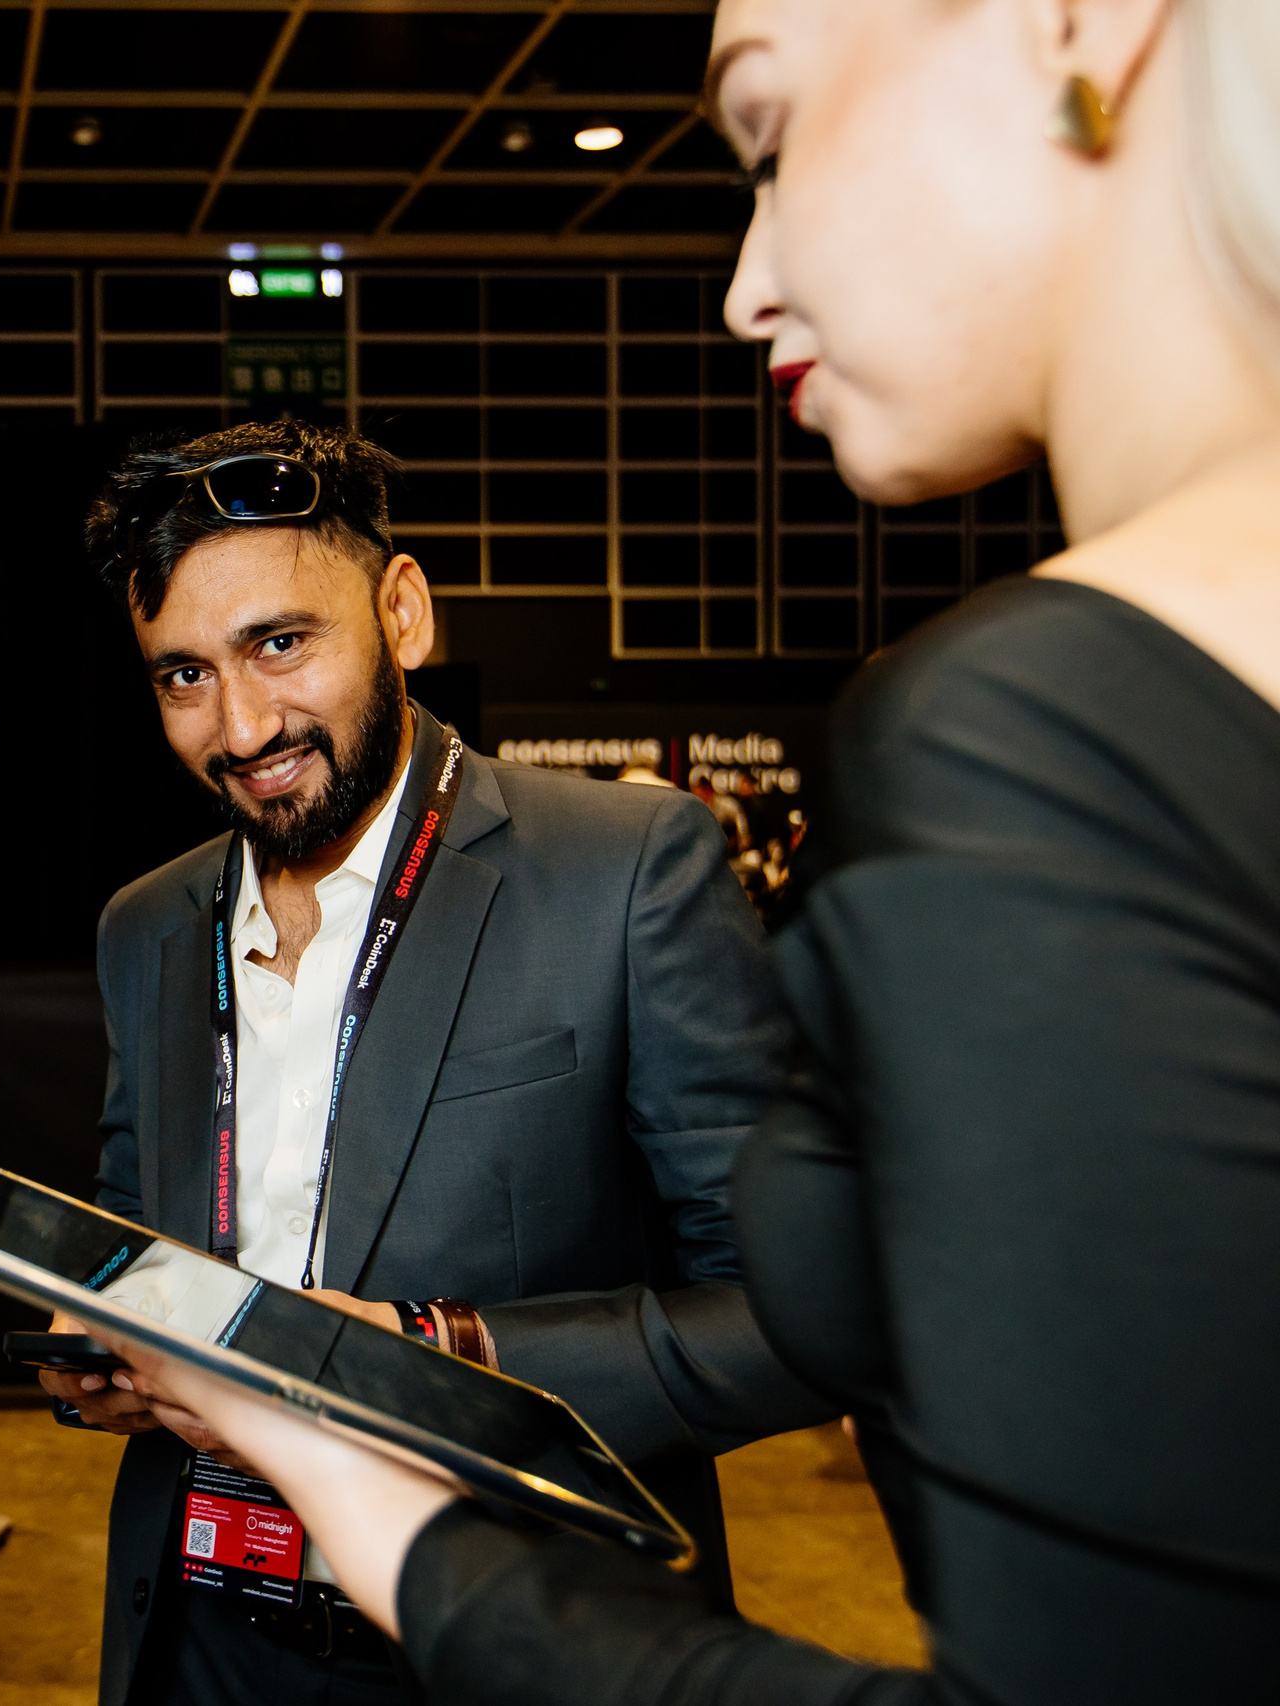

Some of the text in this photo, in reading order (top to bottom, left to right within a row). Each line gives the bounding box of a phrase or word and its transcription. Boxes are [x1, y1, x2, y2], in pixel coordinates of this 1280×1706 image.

[437, 748, 460, 794] CoinDesk
[395, 810, 439, 898] CONSENSUS
[357, 934, 388, 989] CoinDesk
[220, 1032, 233, 1090] CoinDesk
[258, 1520, 293, 1535] midnight
